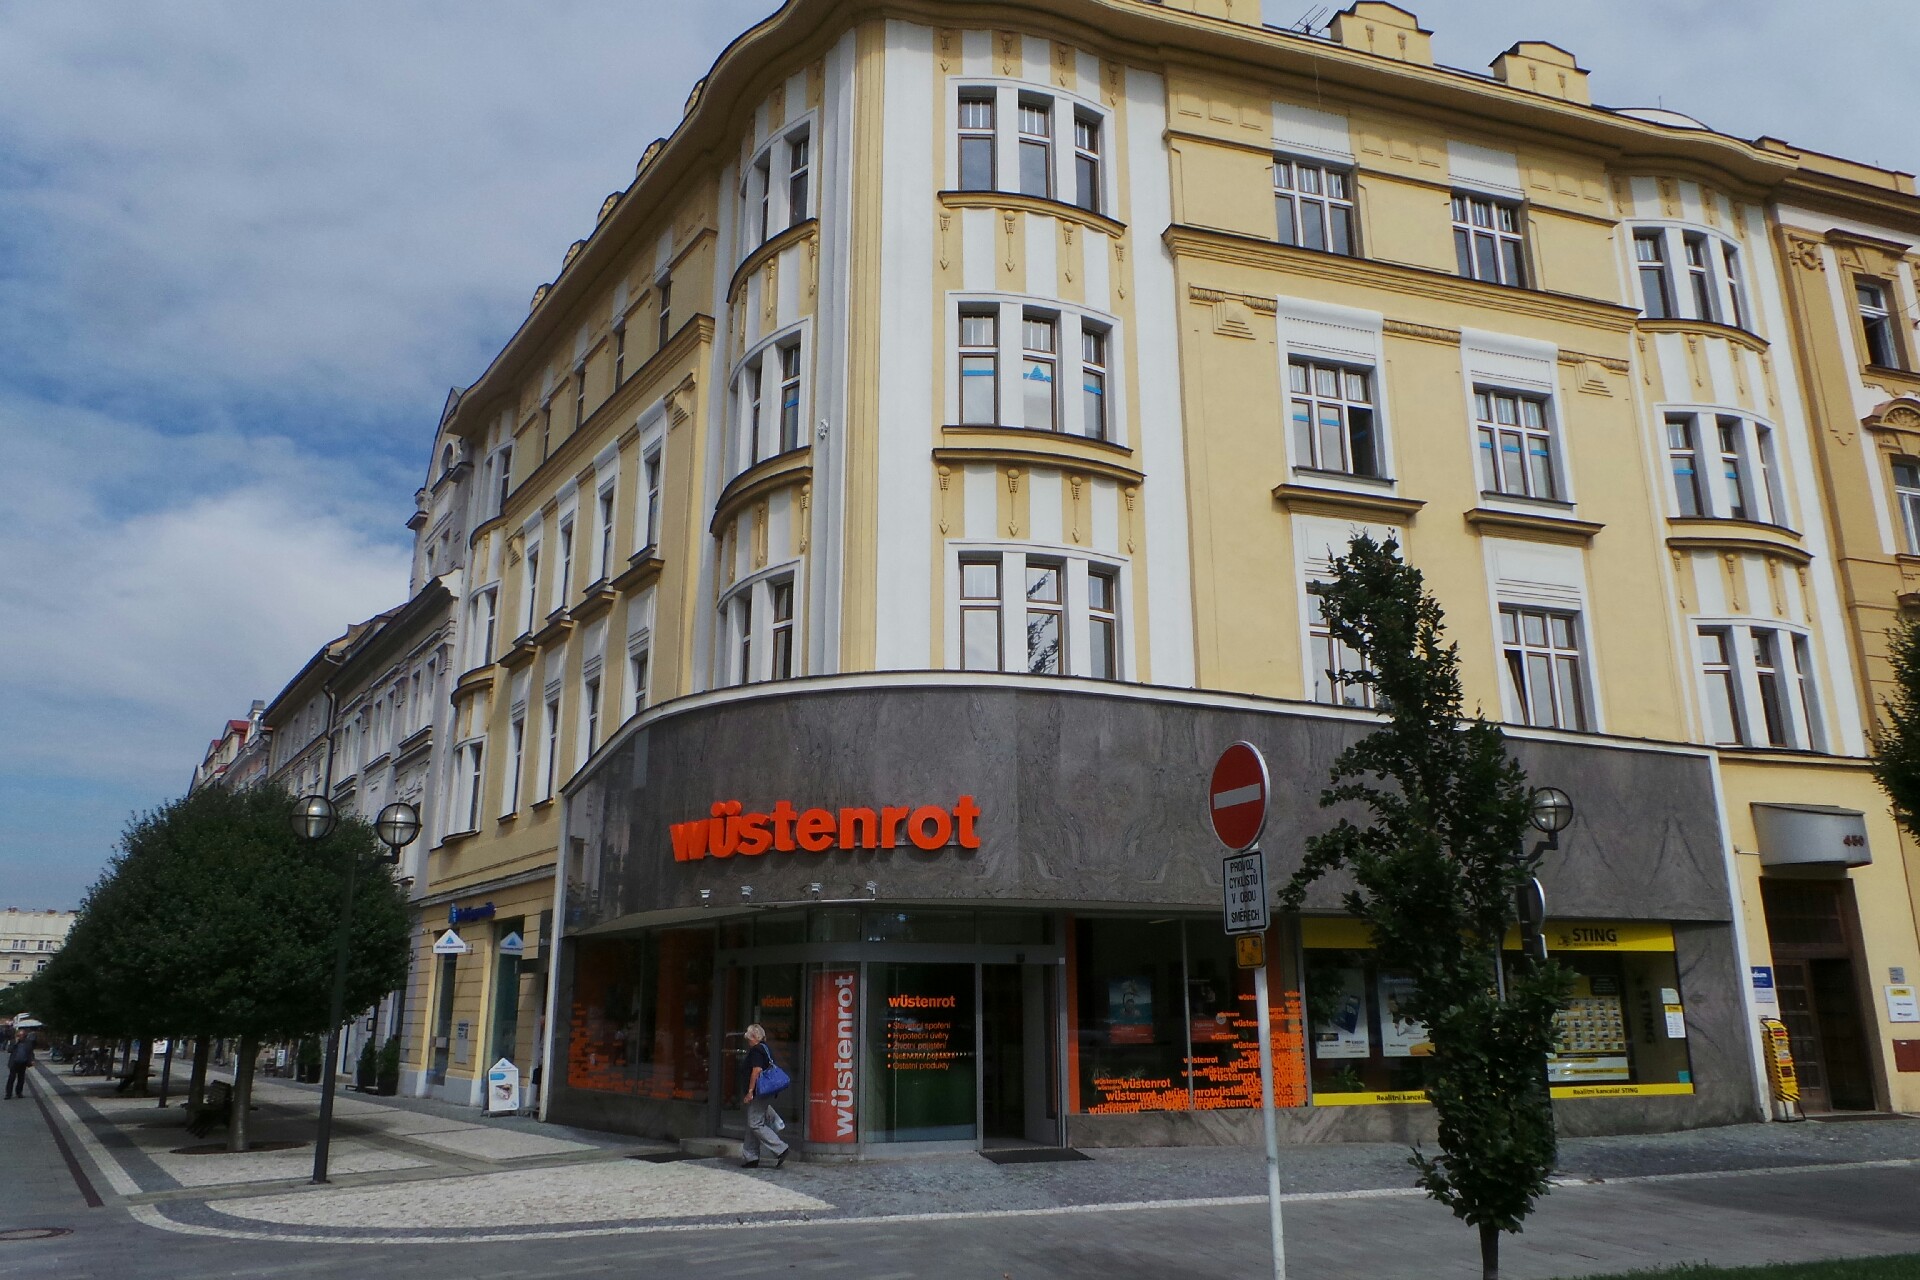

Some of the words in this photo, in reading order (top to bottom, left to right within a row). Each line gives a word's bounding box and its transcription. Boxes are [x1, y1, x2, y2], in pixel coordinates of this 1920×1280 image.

[669, 794, 981, 862] wüstenrot
[1230, 859, 1254, 873] PROVOZ
[1229, 868, 1258, 889] CYKLISTŮ
[1231, 893, 1236, 904] V
[1240, 889, 1257, 903] OBOU
[1231, 908, 1260, 924] SMĚRECH
[1572, 928, 1617, 942] STING
[888, 994, 956, 1008] wüstenrot
[831, 975, 853, 1137] wüstenrot
[1121, 1078, 1171, 1089] wüstenrot
